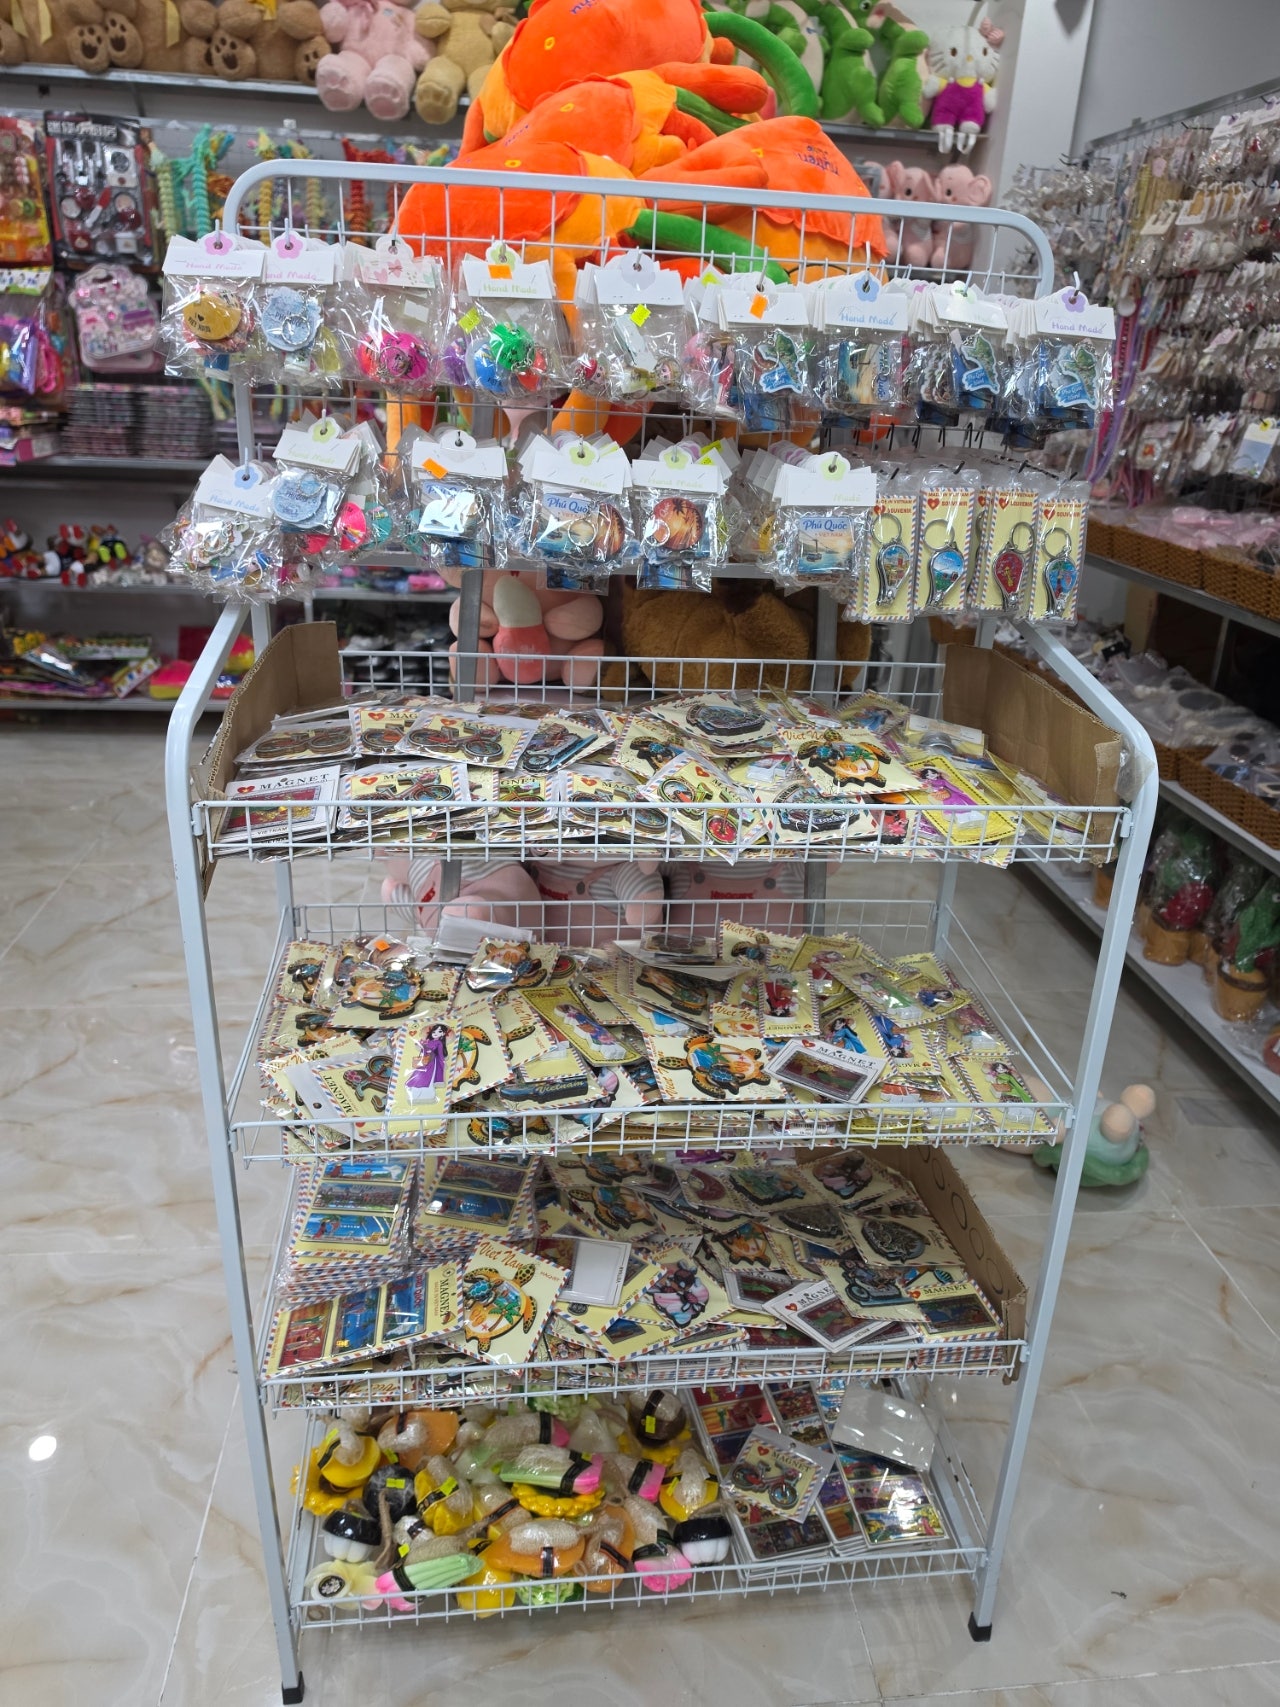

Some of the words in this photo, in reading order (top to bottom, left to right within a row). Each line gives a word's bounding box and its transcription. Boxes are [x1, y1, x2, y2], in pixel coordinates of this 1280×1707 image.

[216, 263, 242, 271] Made
[288, 272, 317, 281] Made
[483, 283, 507, 293] Hand
[512, 284, 537, 294] Made
[841, 313, 865, 323] Hand
[869, 316, 895, 326] Made
[1051, 321, 1076, 331] Hand
[1079, 324, 1103, 334] Made
[579, 476, 608, 488] Made
[676, 480, 704, 489] Made
[209, 494, 234, 506] Hand
[237, 500, 260, 513] Made
[547, 497, 567, 508] Phú
[803, 519, 822, 530] Phú
[824, 519, 848, 531] Quốc
[782, 730, 805, 740] Viet
[260, 773, 330, 790] MAGNET
[714, 1004, 736, 1017] Viet
[818, 1045, 878, 1068] MAGNET
[323, 1075, 355, 1114] MAGNET
[536, 1080, 584, 1096] Vietnam
[479, 1241, 501, 1261] Viet
[924, 1284, 968, 1295] MAGNET
[440, 1279, 451, 1319] MAGNET
